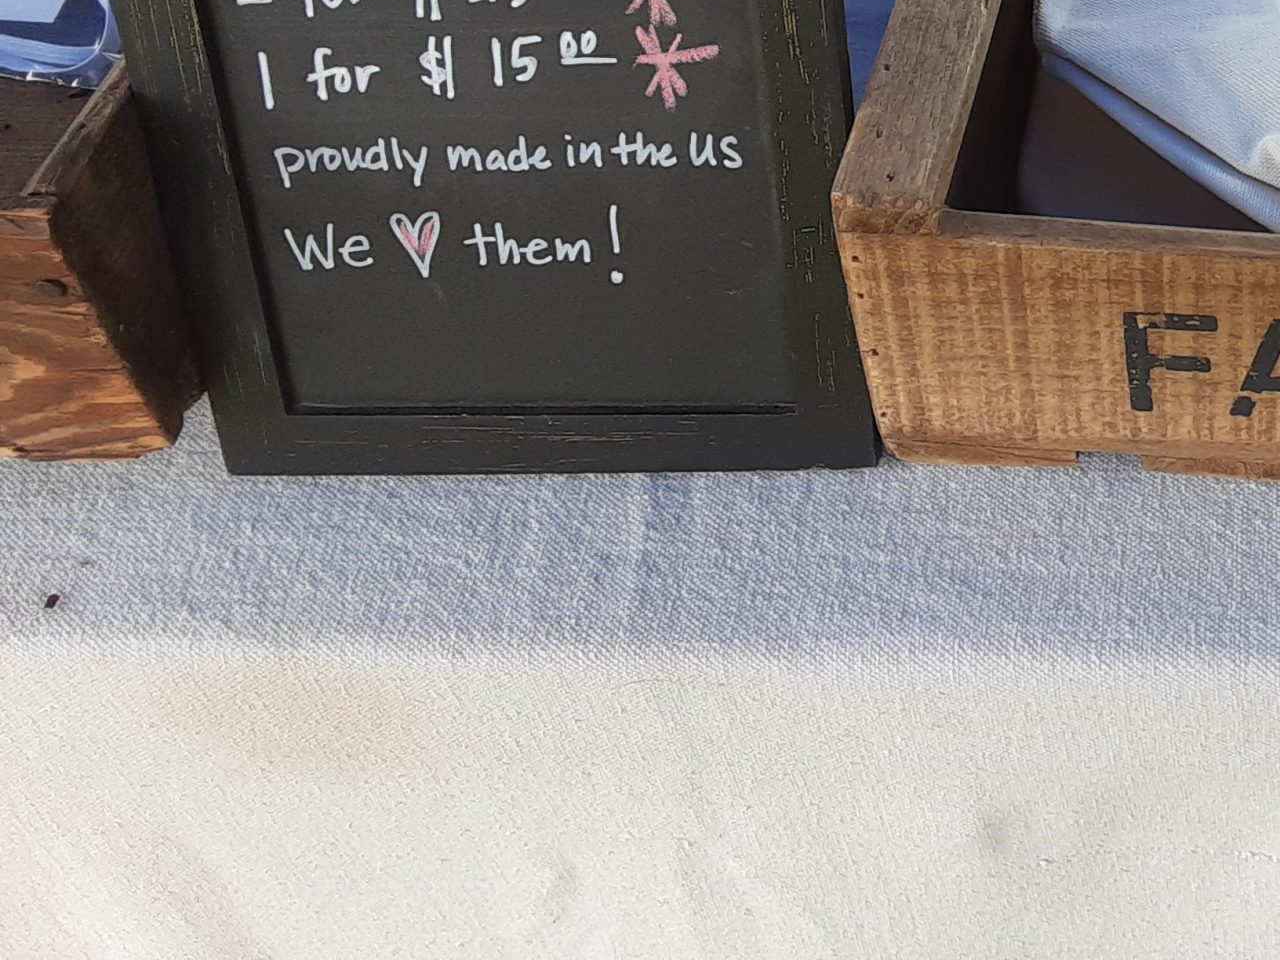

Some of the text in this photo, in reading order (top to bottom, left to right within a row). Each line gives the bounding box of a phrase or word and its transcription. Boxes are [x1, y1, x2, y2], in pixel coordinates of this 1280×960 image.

[257, 51, 275, 110] 1
[305, 47, 381, 101] for
[418, 35, 455, 99] $
[273, 132, 744, 187] proudly made in the US
[284, 222, 374, 271] We
